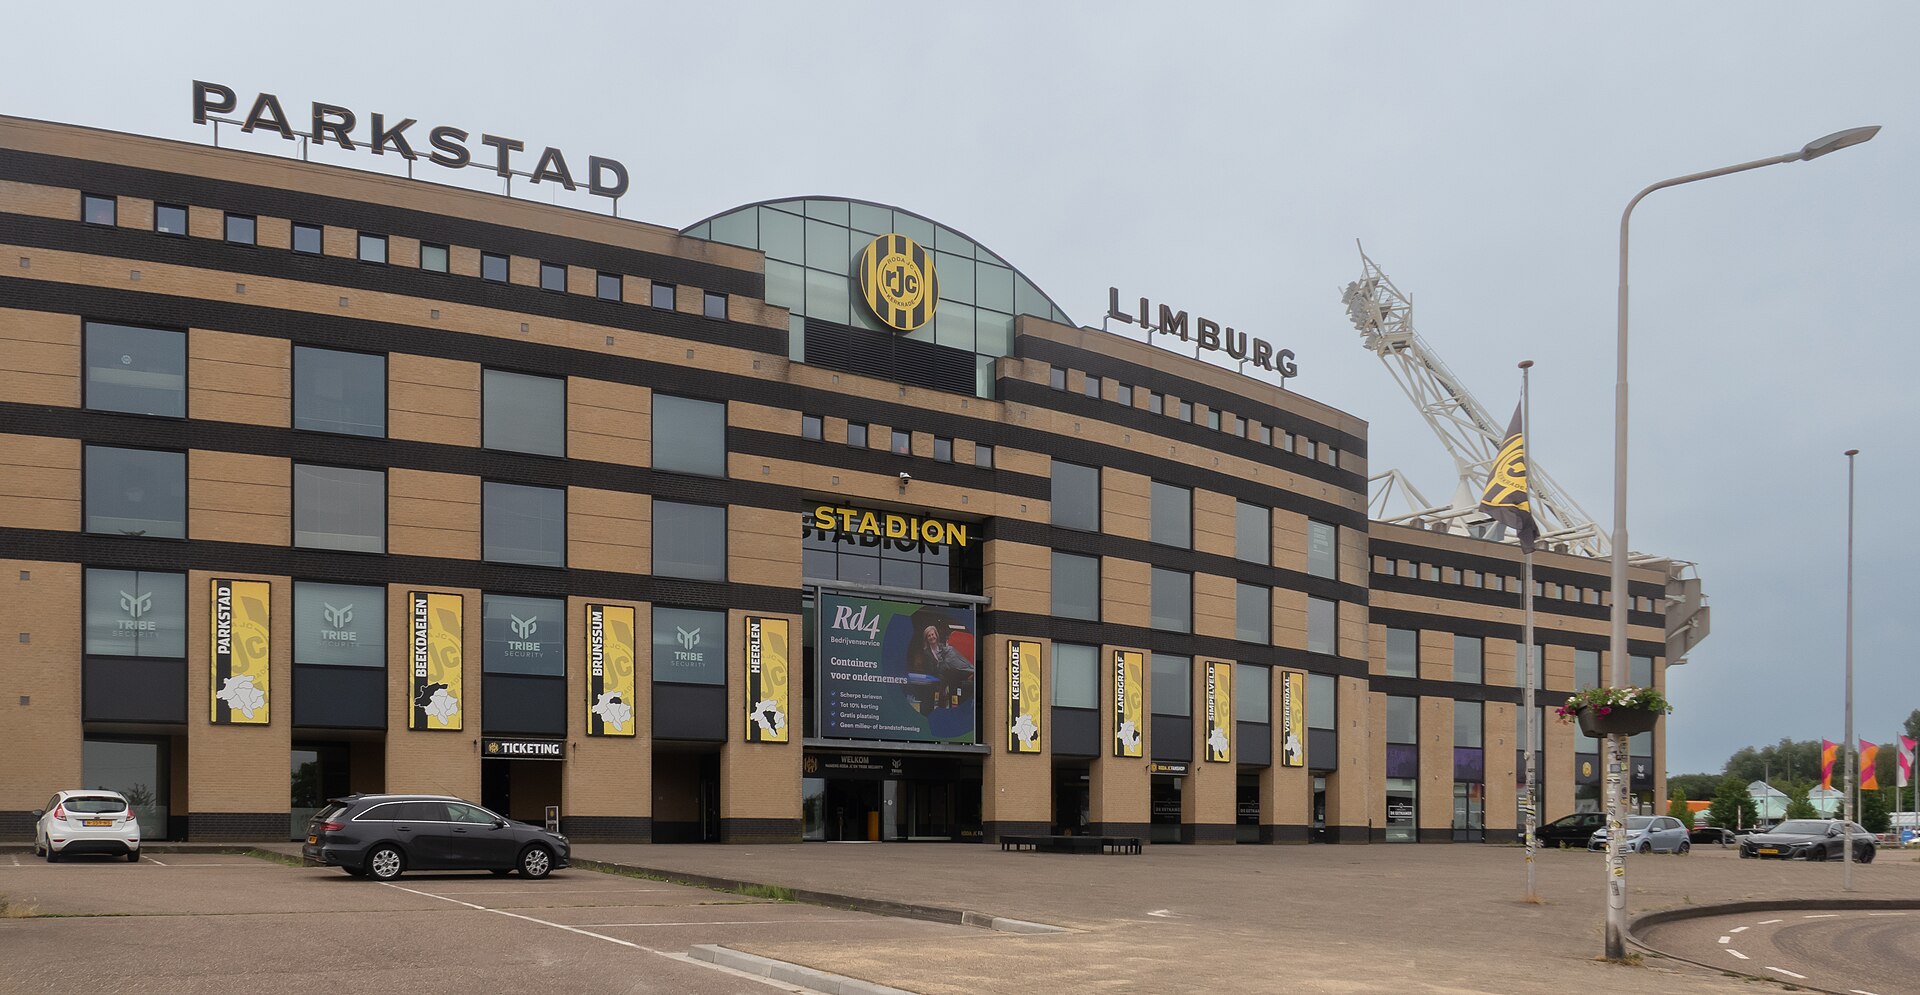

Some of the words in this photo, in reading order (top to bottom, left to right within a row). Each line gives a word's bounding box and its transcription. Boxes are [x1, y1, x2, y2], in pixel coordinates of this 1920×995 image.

[192, 79, 629, 198] PARKSTAD
[887, 256, 905, 264] RODA
[906, 262, 915, 270] JC
[886, 294, 915, 307] KERKRADE
[1109, 286, 1298, 378] LIMBURG
[814, 505, 967, 547] STADION
[117, 620, 156, 631] TRIBE
[217, 586, 231, 655] PARKSTAD
[831, 604, 881, 640] Rd4
[112, 630, 160, 638] SECURITY
[321, 630, 357, 641] TRIBE
[415, 599, 427, 678] BEEKDAELEN
[508, 641, 541, 651] TRIBE
[592, 611, 603, 677] BRUNSSUM
[830, 636, 881, 647] Bedrijvenservice
[504, 650, 544, 658] SECURITY
[751, 623, 760, 674] HEERLEN
[674, 651, 703, 661] TRIBE
[830, 656, 878, 669] Containers
[671, 660, 706, 668] SECURITY
[830, 671, 851, 681] voor
[852, 673, 908, 685] ondernemers
[840, 691, 861, 700] Scherpe
[860, 703, 879, 711] korting
[856, 712, 879, 721] plaatsing
[501, 742, 559, 755] TICKETING
[841, 755, 869, 764] WELKOM
